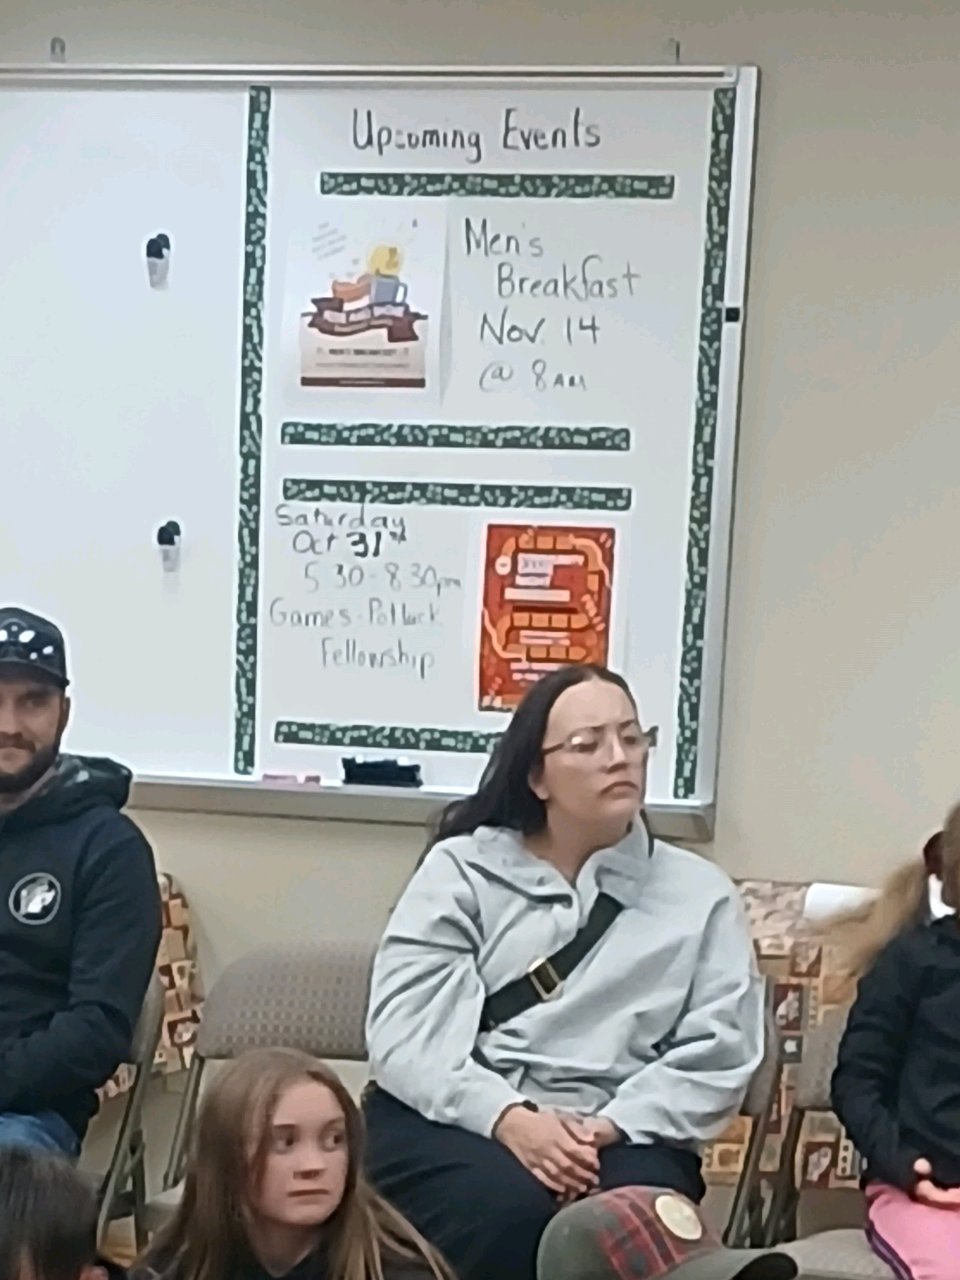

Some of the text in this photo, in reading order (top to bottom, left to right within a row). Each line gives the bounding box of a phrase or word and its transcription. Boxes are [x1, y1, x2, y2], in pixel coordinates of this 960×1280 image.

[352, 106, 601, 164] Upcoming Events
[465, 217, 543, 257] Men's
[497, 254, 641, 301] Breakfast
[566, 315, 600, 345] 14
[479, 360, 514, 392] @
[275, 503, 406, 534] Saturday
